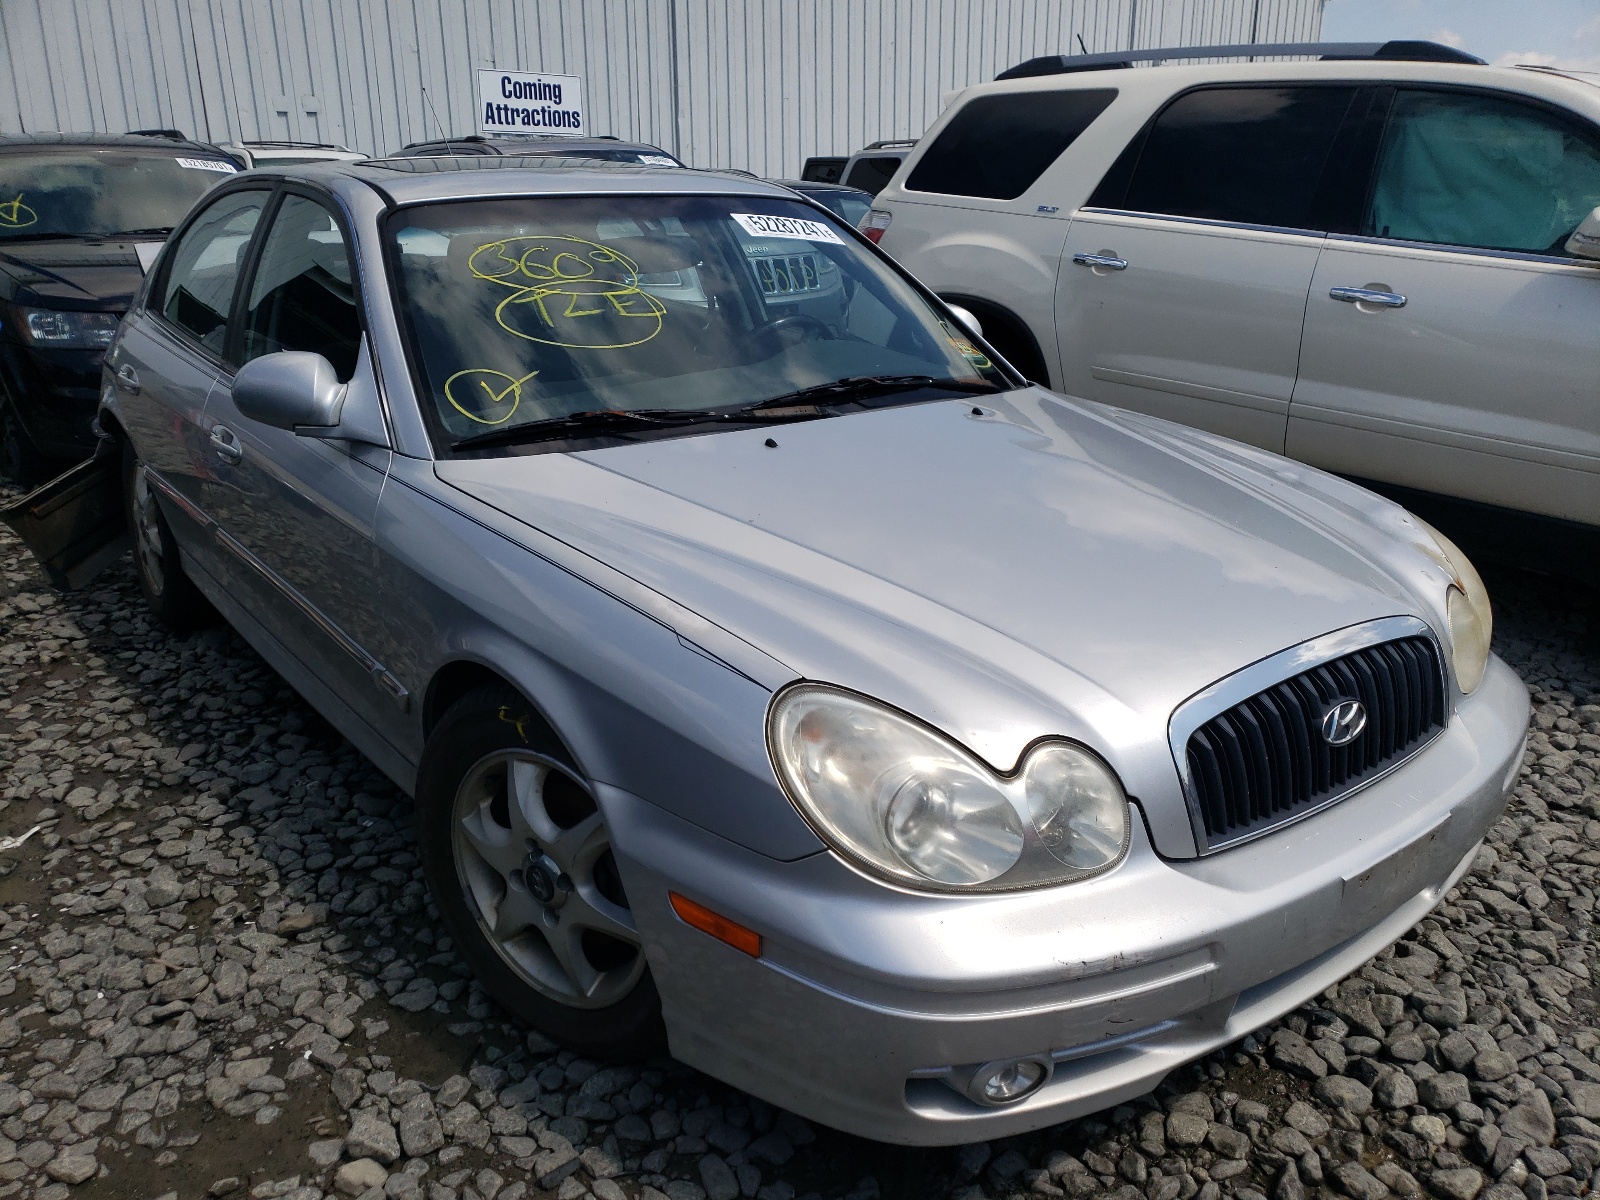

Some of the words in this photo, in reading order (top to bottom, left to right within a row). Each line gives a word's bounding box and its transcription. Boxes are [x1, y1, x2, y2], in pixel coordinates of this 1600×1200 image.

[501, 75, 562, 105] Coming
[485, 101, 581, 129] Attractions
[746, 215, 828, 238] 52287241
[747, 245, 770, 255] Jeep
